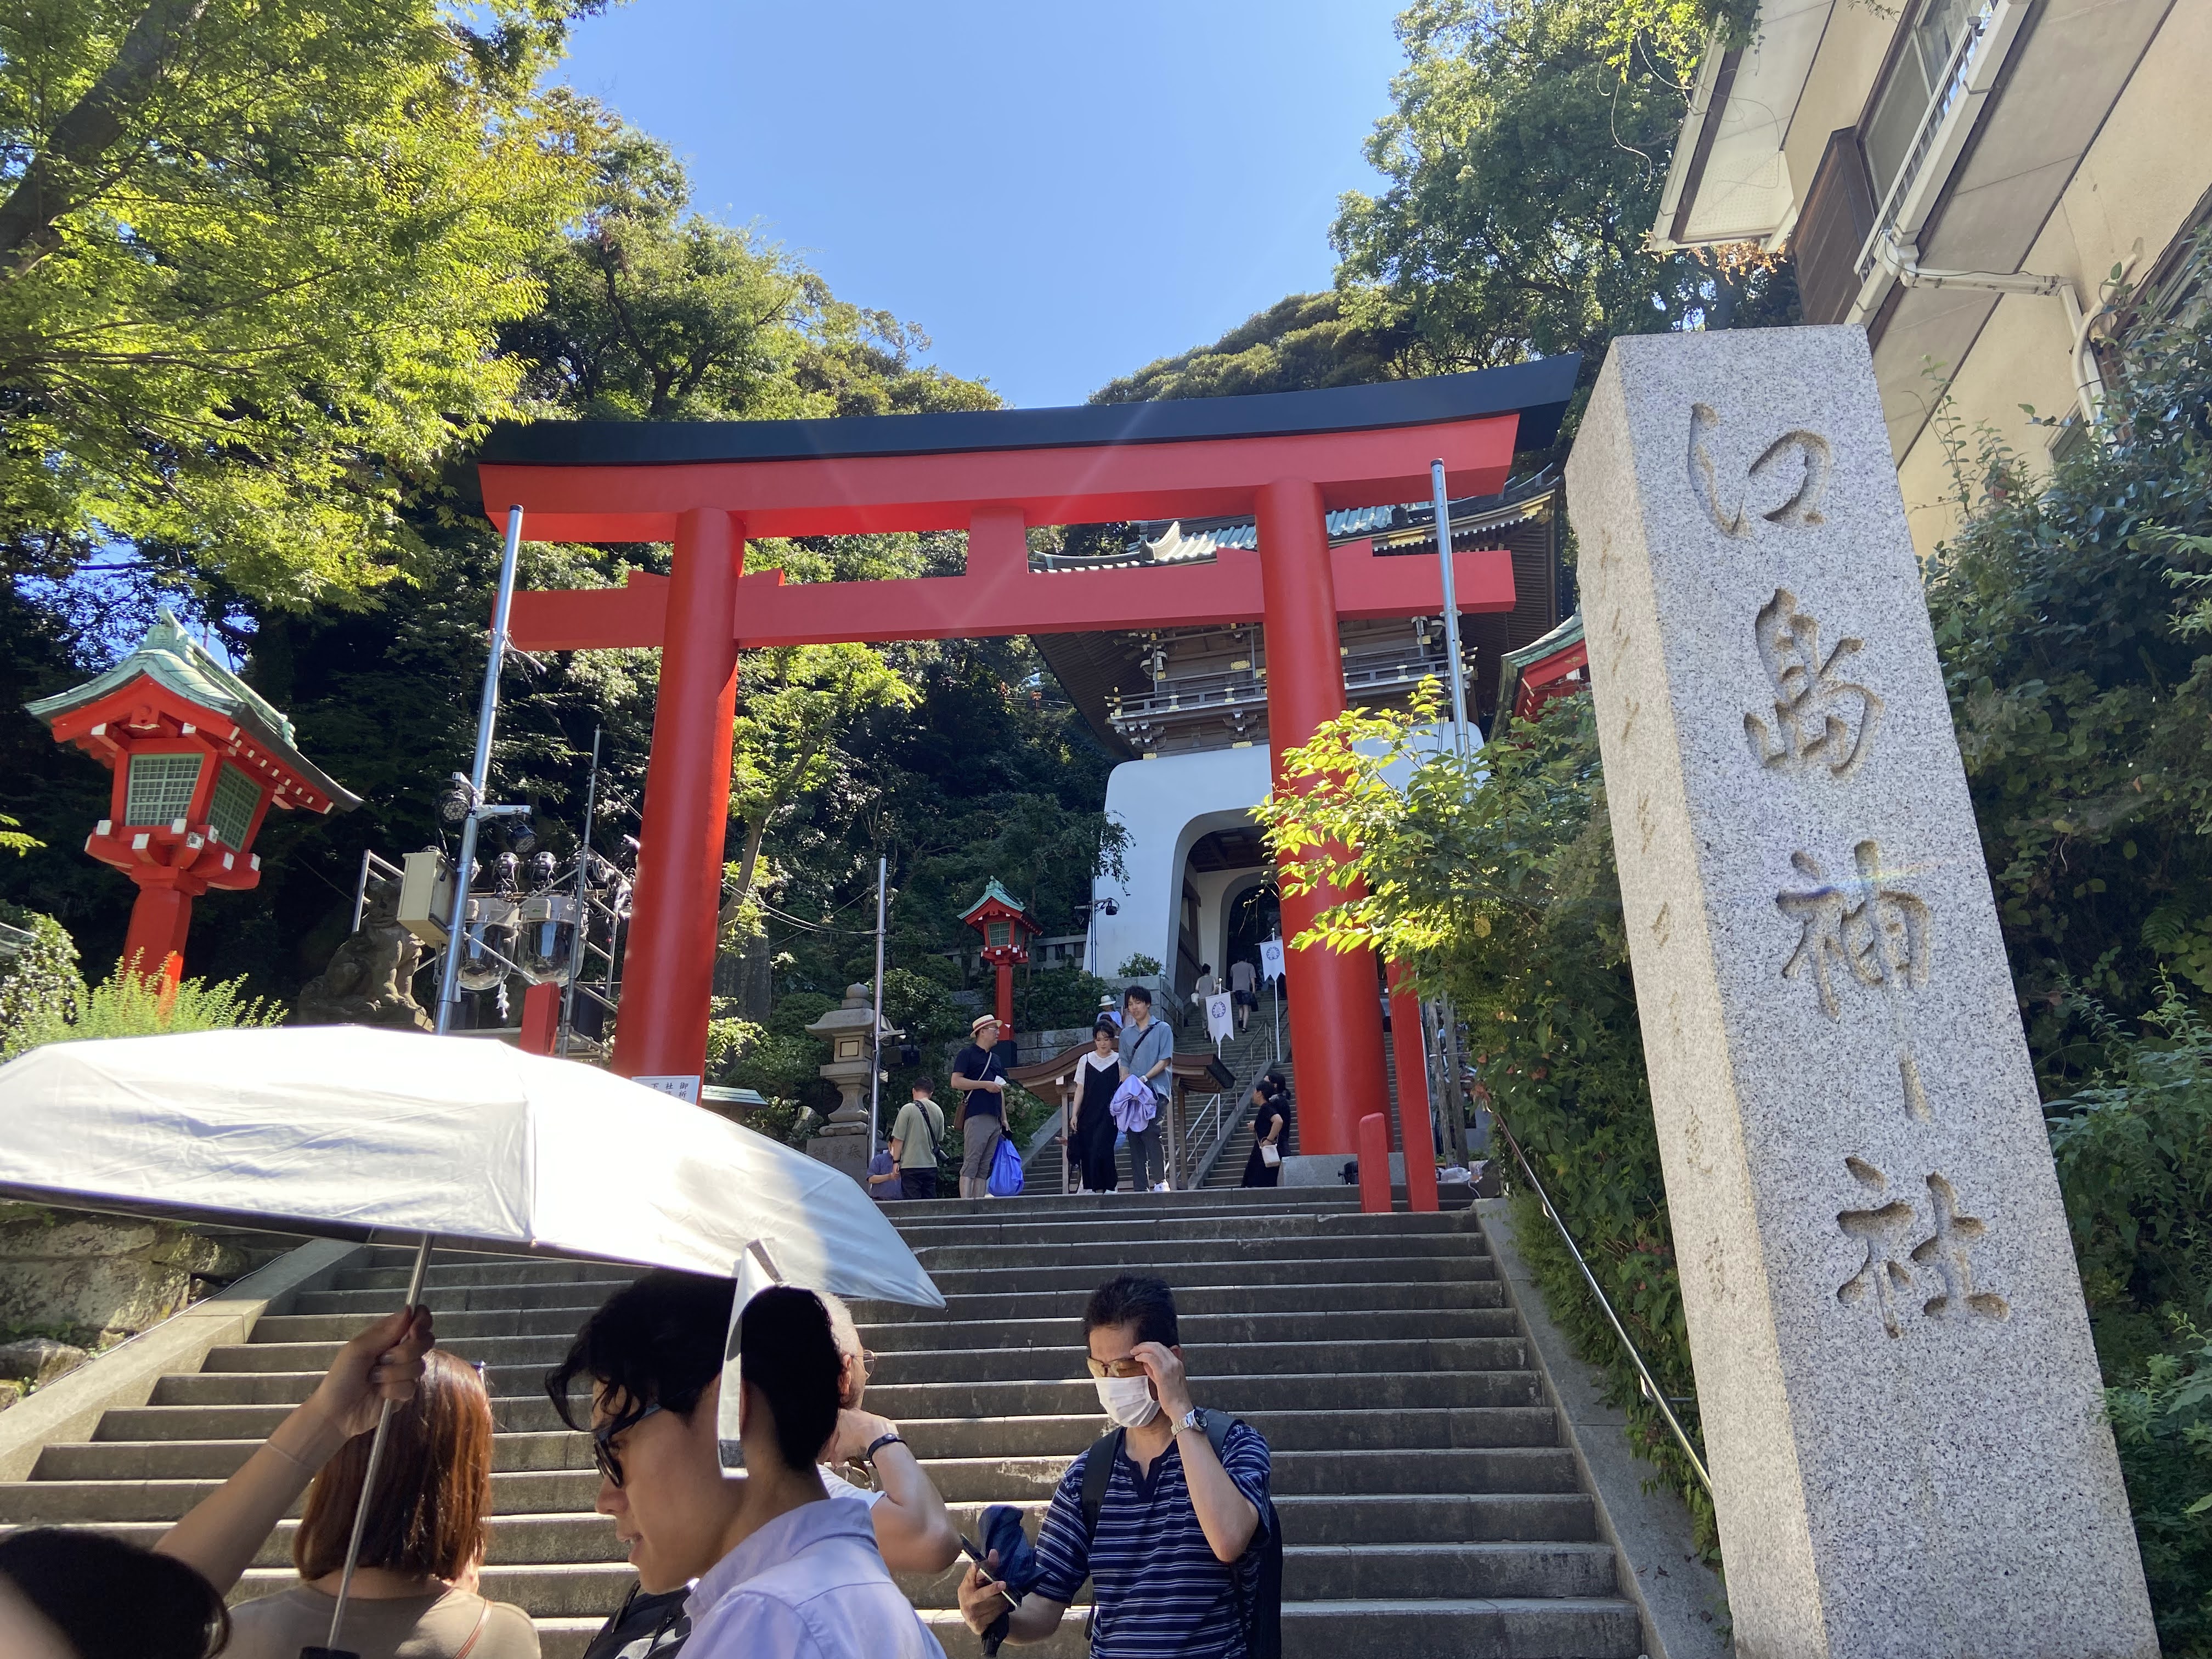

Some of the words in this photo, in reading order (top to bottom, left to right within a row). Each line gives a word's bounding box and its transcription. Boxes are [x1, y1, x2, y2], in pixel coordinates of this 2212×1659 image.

[678, 1082, 689, 1100] 御祈
[1687, 401, 2010, 1339] 江島神社
